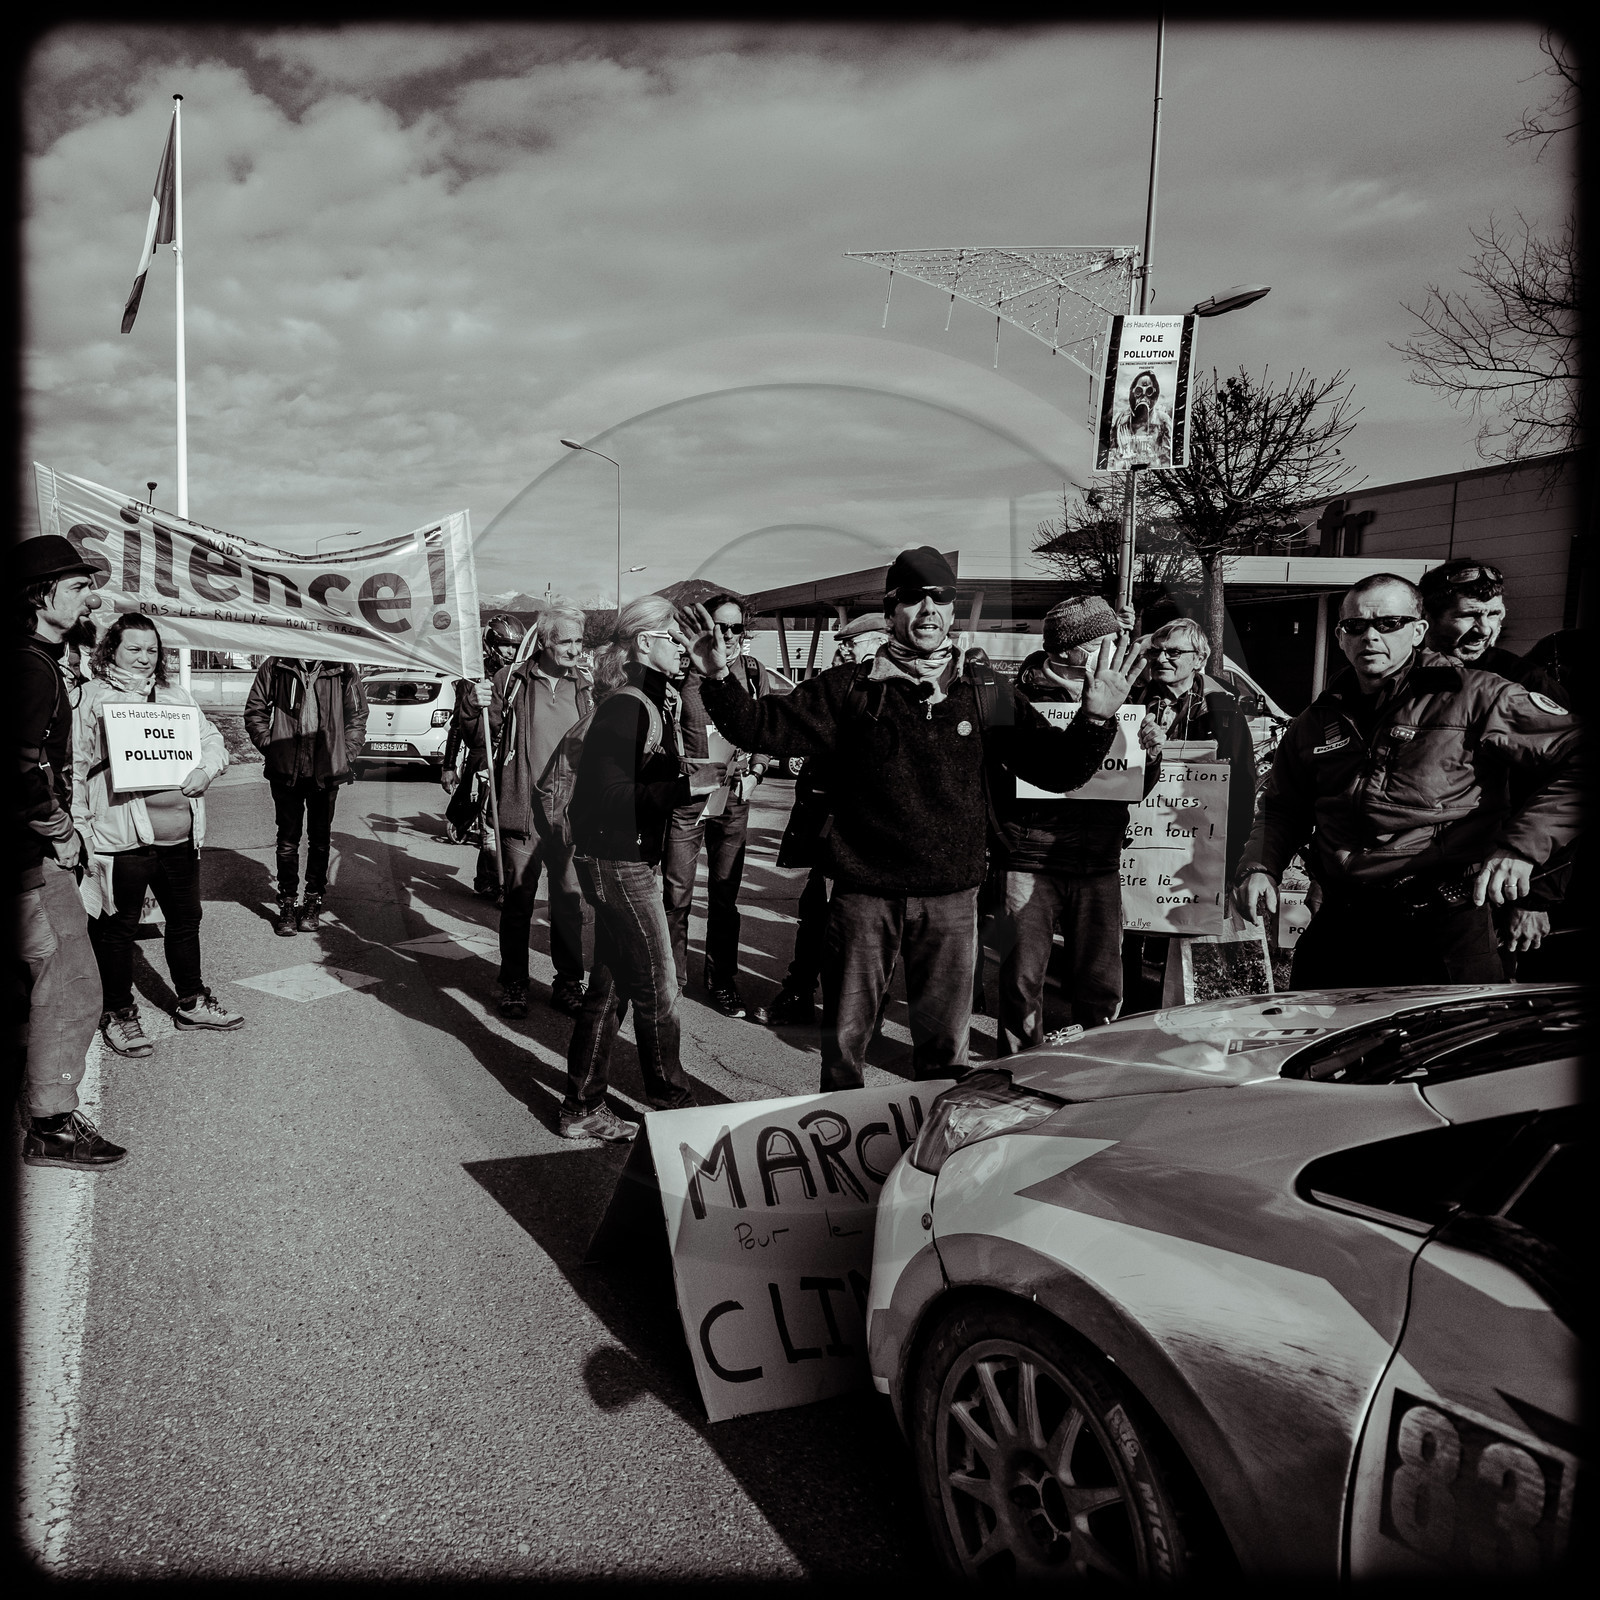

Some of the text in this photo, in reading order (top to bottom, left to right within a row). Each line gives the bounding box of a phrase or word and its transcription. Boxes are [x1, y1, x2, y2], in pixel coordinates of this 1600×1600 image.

[1123, 350, 1175, 358] POLLUTION
[286, 618, 322, 631] MONTE
[111, 709, 191, 721] Les Hautes-Alpes en
[1123, 712, 1137, 721] en
[144, 728, 176, 740] POLE
[125, 750, 193, 761] POLLUTION
[1166, 822, 1198, 838] fout
[1208, 823, 1215, 839] !
[1157, 874, 1173, 886] là
[1156, 894, 1200, 904] avant
[1284, 898, 1298, 906] Les
[734, 1209, 863, 1251] Pour le
